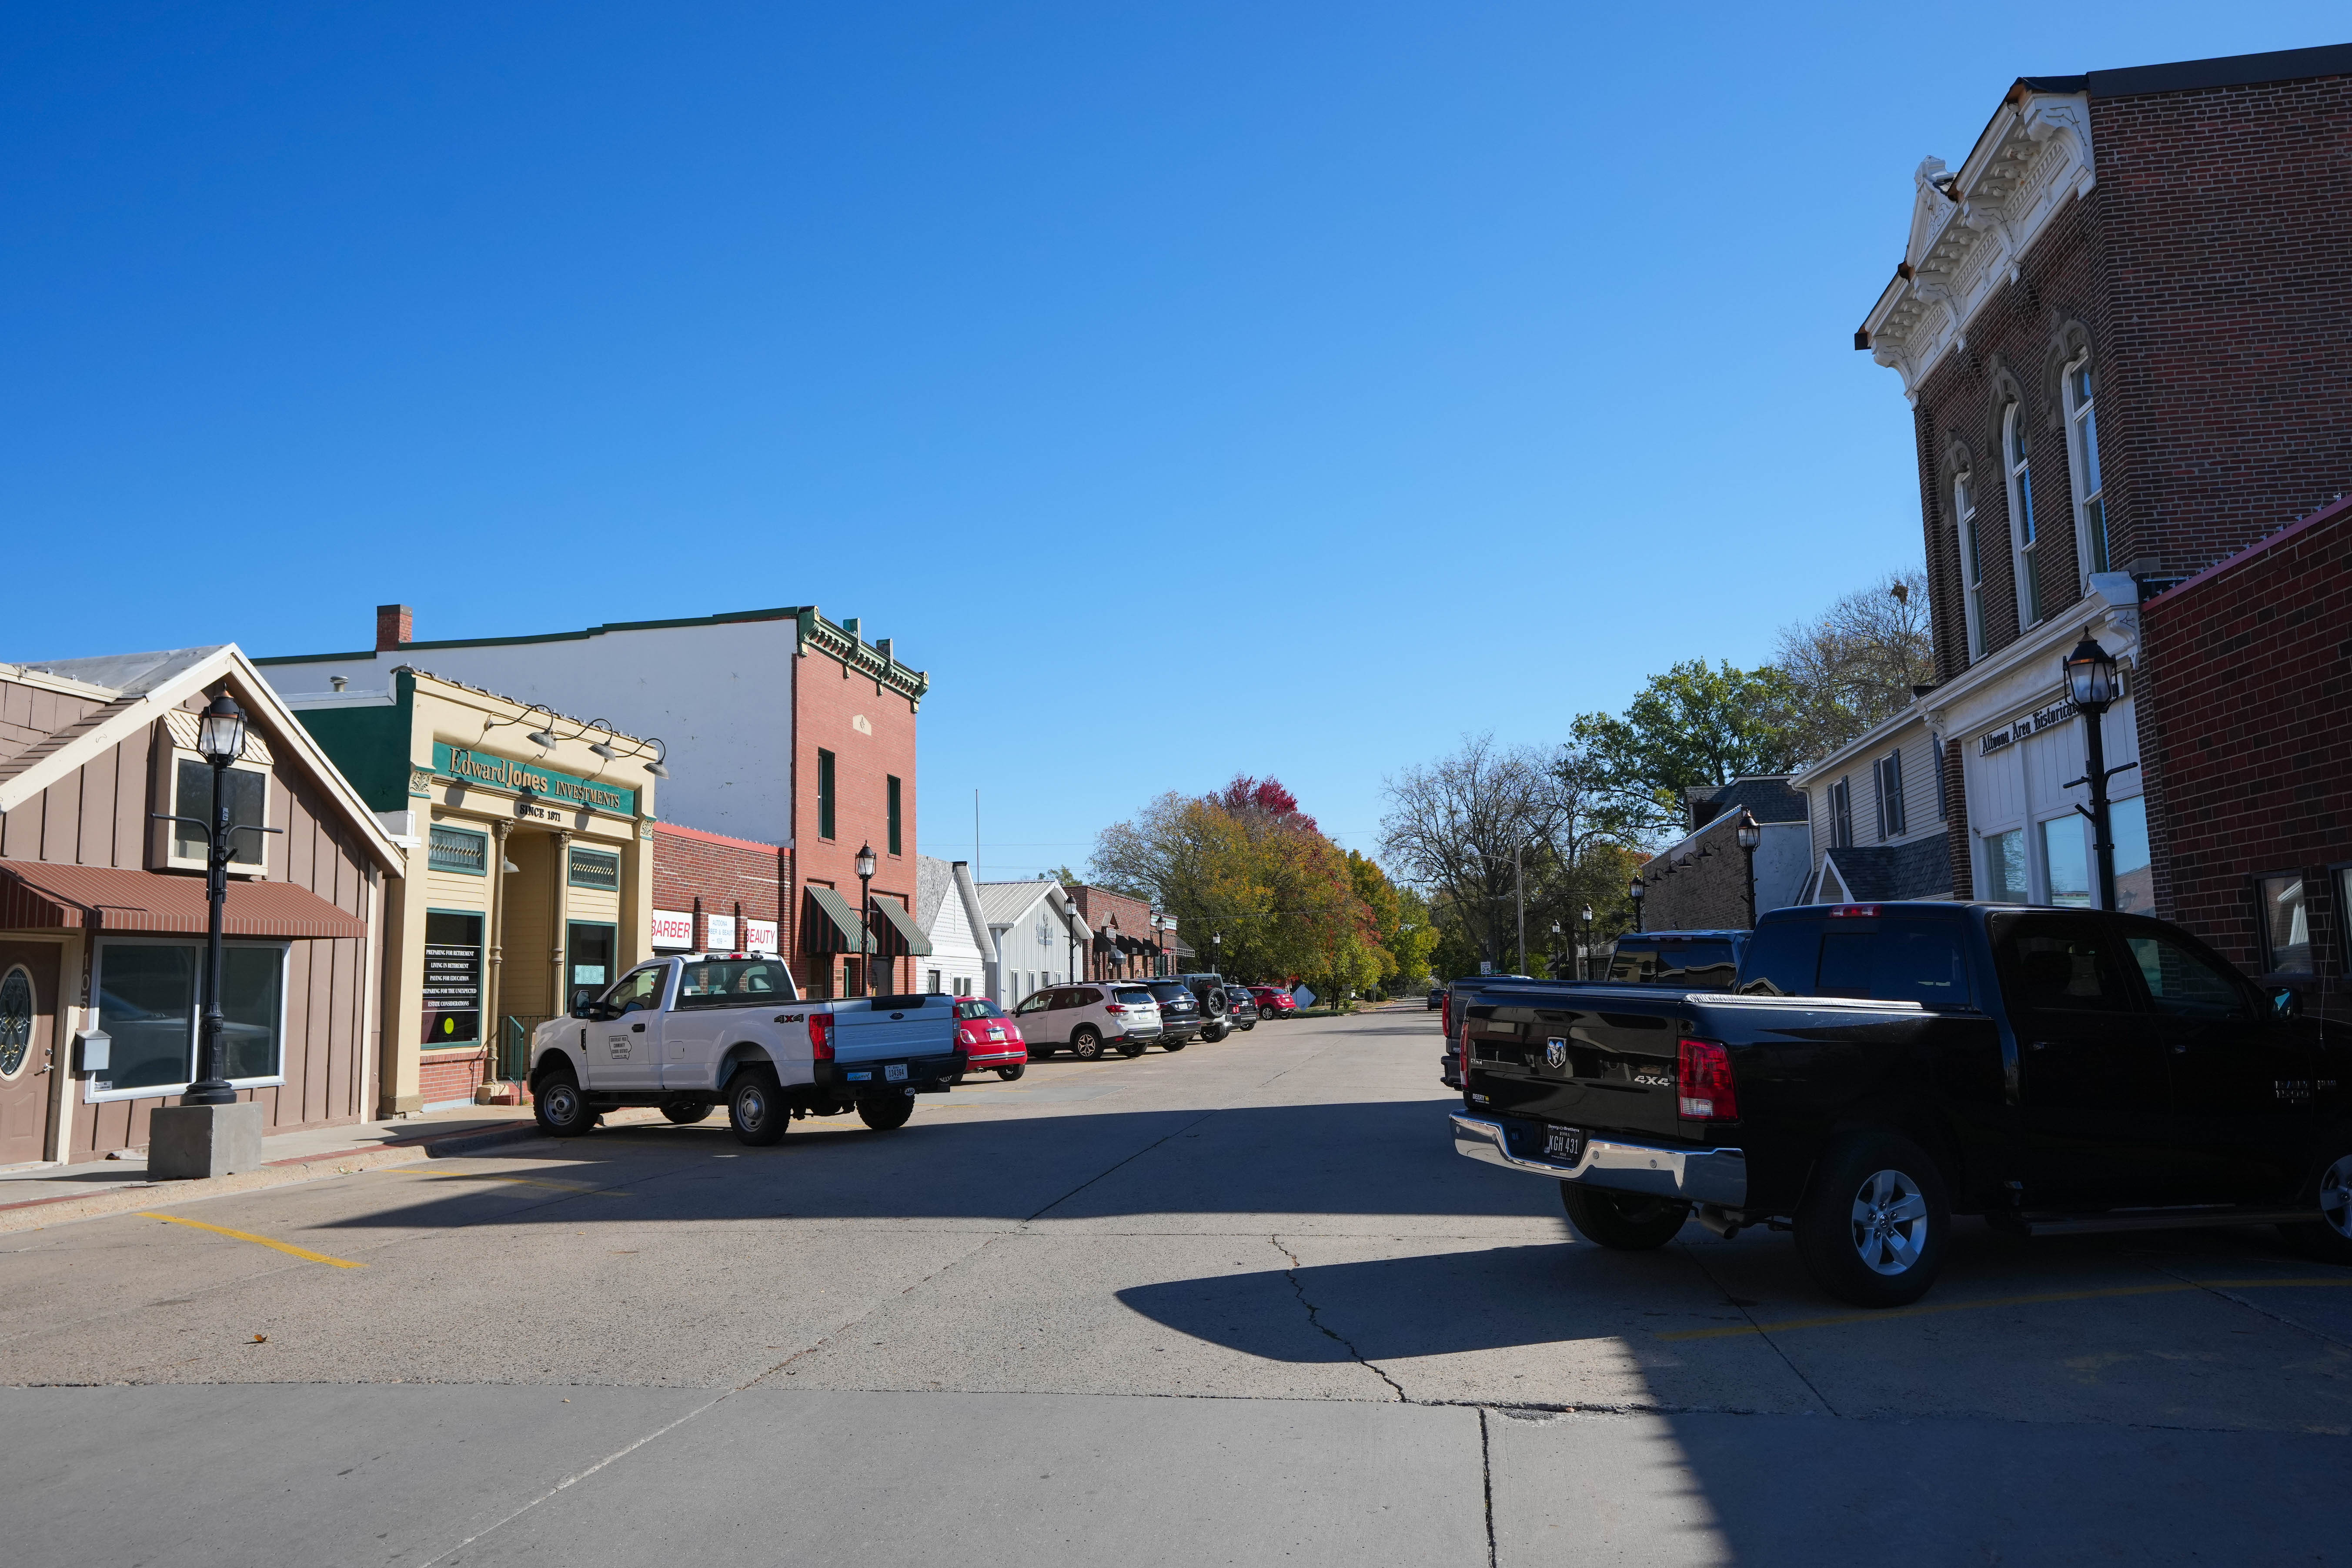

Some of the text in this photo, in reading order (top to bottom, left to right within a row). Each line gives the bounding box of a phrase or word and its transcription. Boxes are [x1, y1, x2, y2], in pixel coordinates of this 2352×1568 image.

[1982, 732, 2009, 754] Altoona
[2012, 721, 2031, 741] Area
[449, 748, 619, 808] Edward Jones INVESTMENTS
[520, 804, 561, 822] SINCE 1871
[80, 952, 90, 1012] 105
[889, 1069, 904, 1077] 134364
[1549, 1135, 1564, 1152] KGH
[1566, 1137, 1578, 1154] 431
